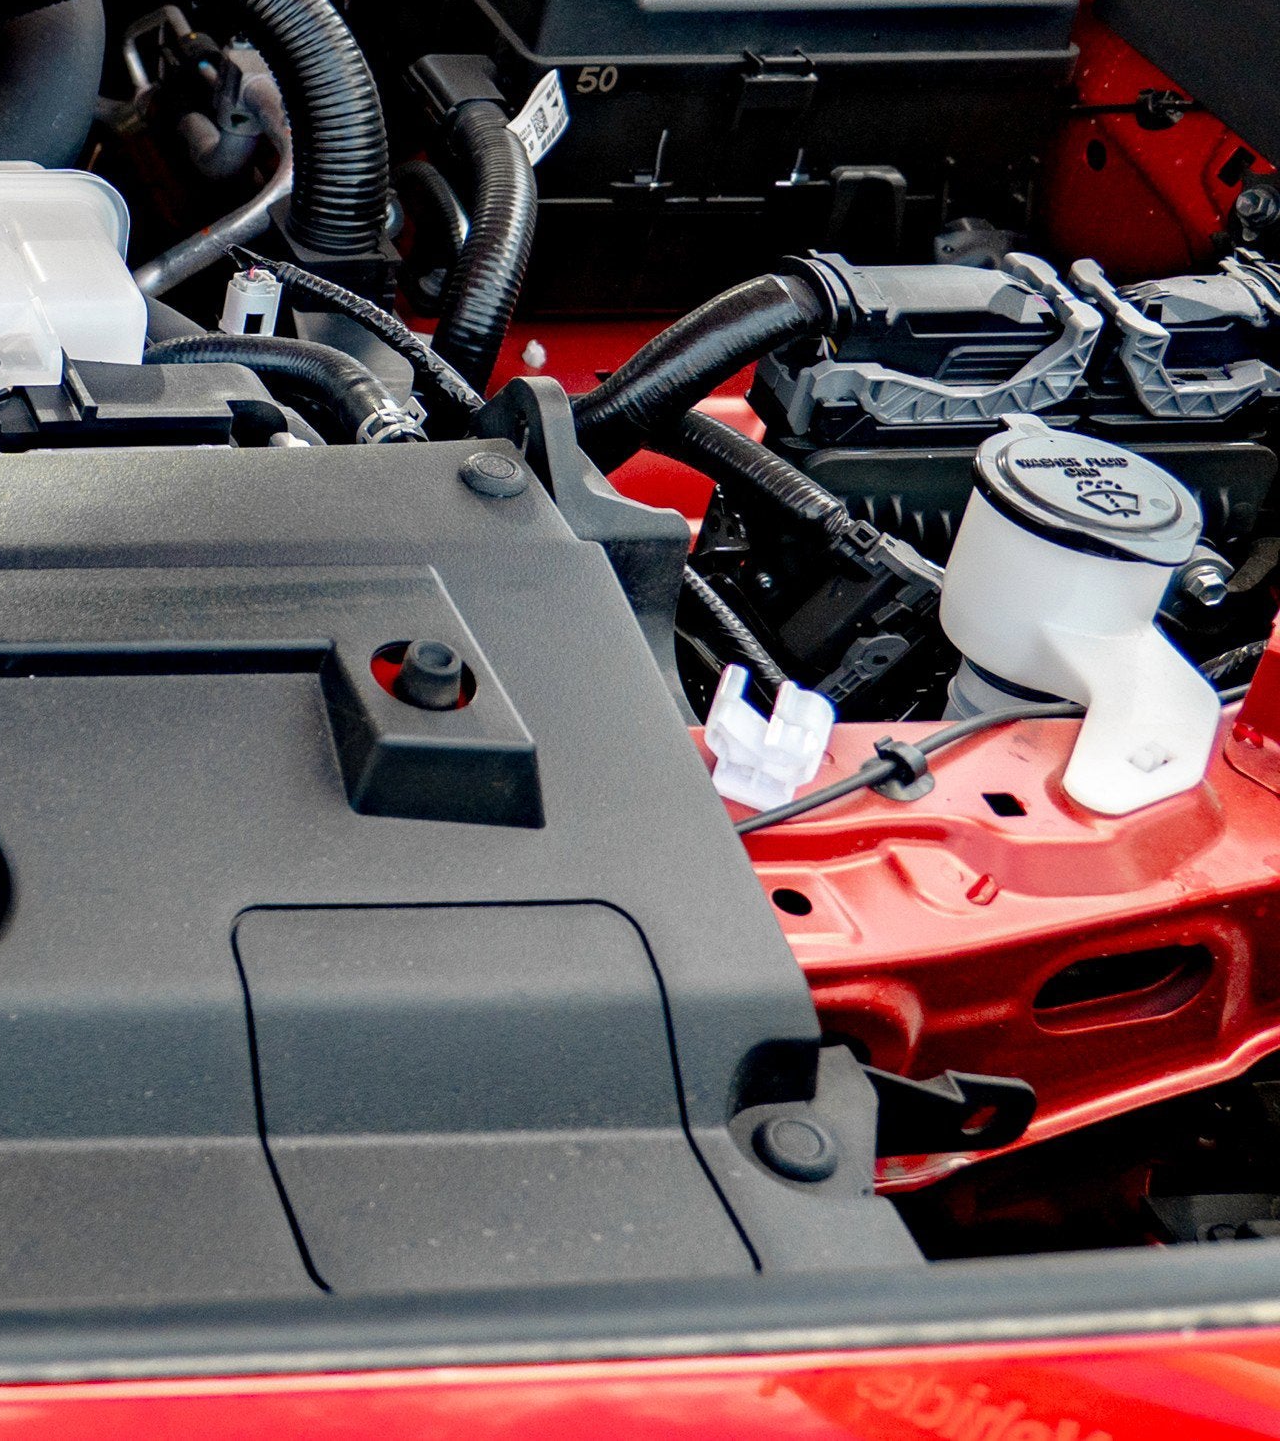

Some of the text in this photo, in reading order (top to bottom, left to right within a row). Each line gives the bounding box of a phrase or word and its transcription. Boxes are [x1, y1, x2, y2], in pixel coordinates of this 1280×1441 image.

[576, 65, 619, 94] 50
[1015, 457, 1128, 469] WASHER FLUID
[1064, 468, 1102, 477] ONLY
